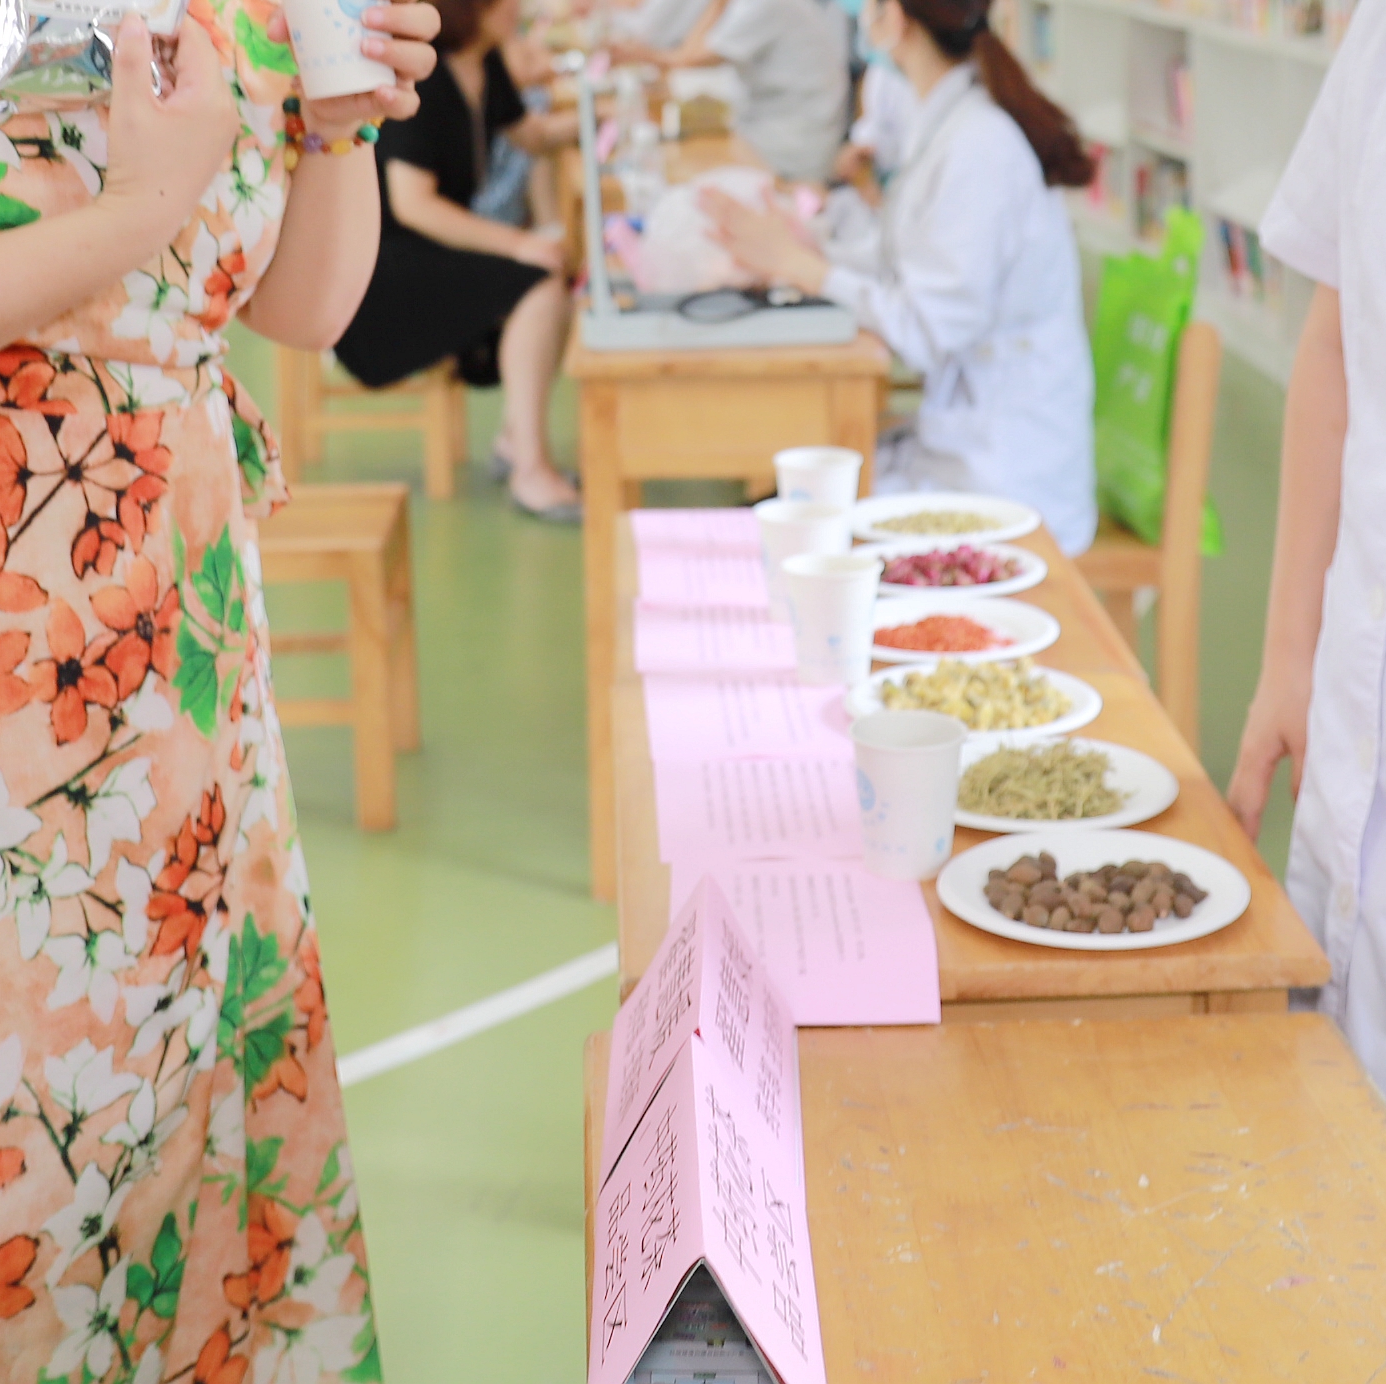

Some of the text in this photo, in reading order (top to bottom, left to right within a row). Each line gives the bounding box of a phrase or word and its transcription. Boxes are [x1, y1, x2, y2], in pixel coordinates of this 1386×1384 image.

[600, 1180, 632, 1368] 品尝区
[641, 1103, 680, 1294] 中药花茶
[706, 1084, 762, 1286] 中药花茶
[761, 1167, 807, 1361] 品尝区
